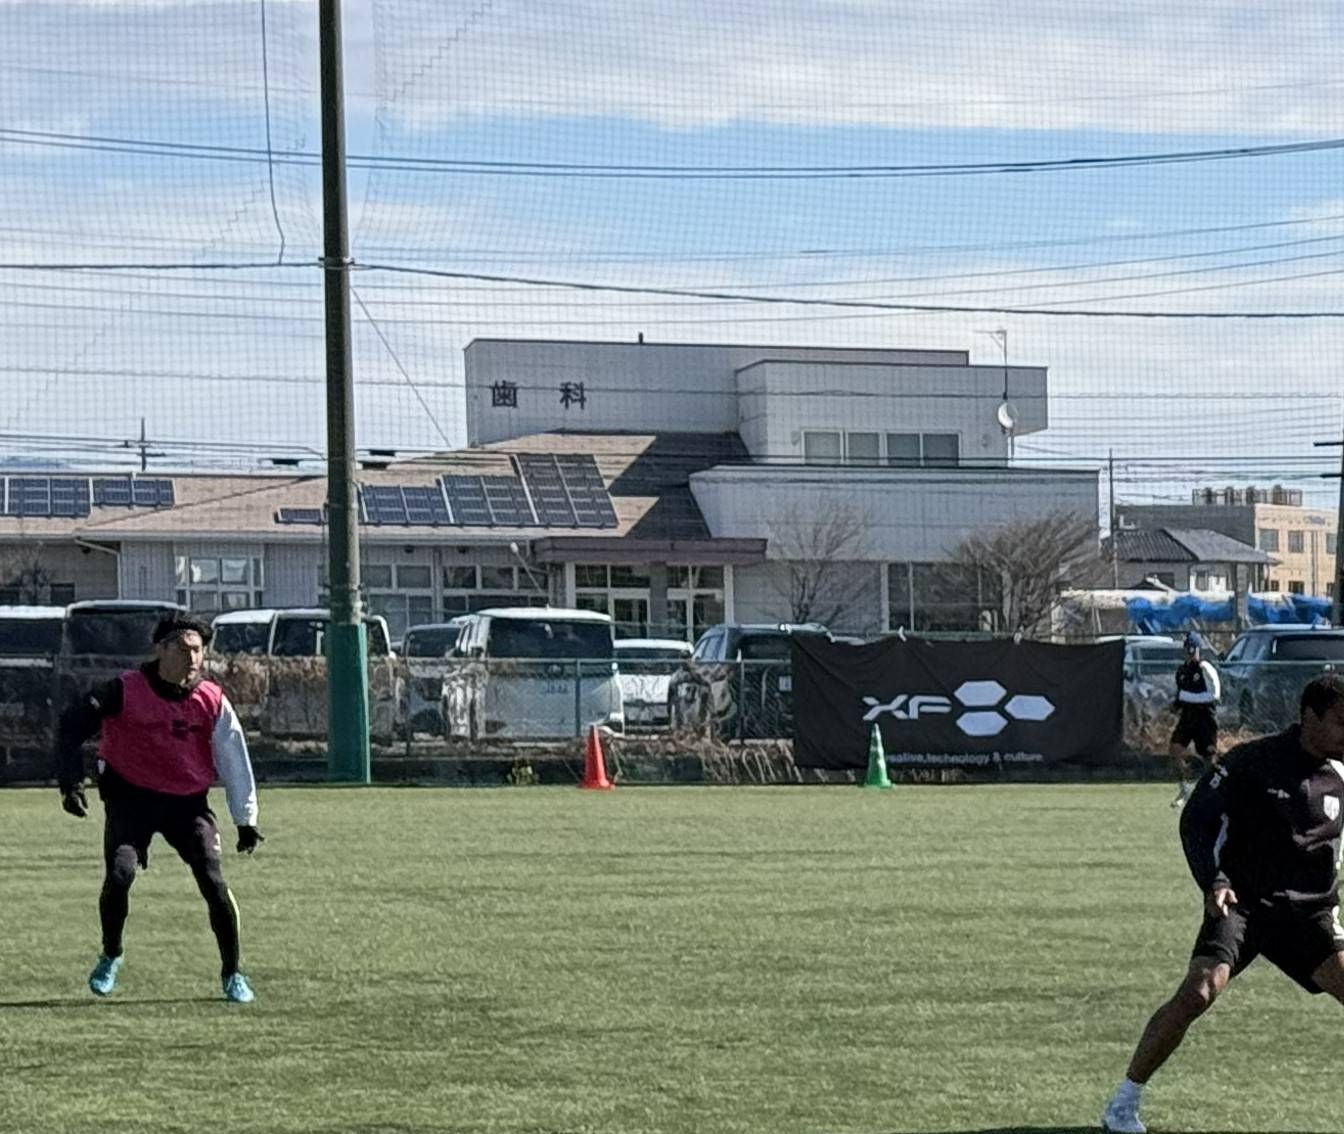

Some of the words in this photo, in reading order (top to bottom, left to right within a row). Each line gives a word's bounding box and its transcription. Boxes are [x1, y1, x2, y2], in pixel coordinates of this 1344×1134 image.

[491, 380, 586, 409] 歯科
[862, 694, 951, 721] XF
[885, 752, 990, 765] reative,technology
